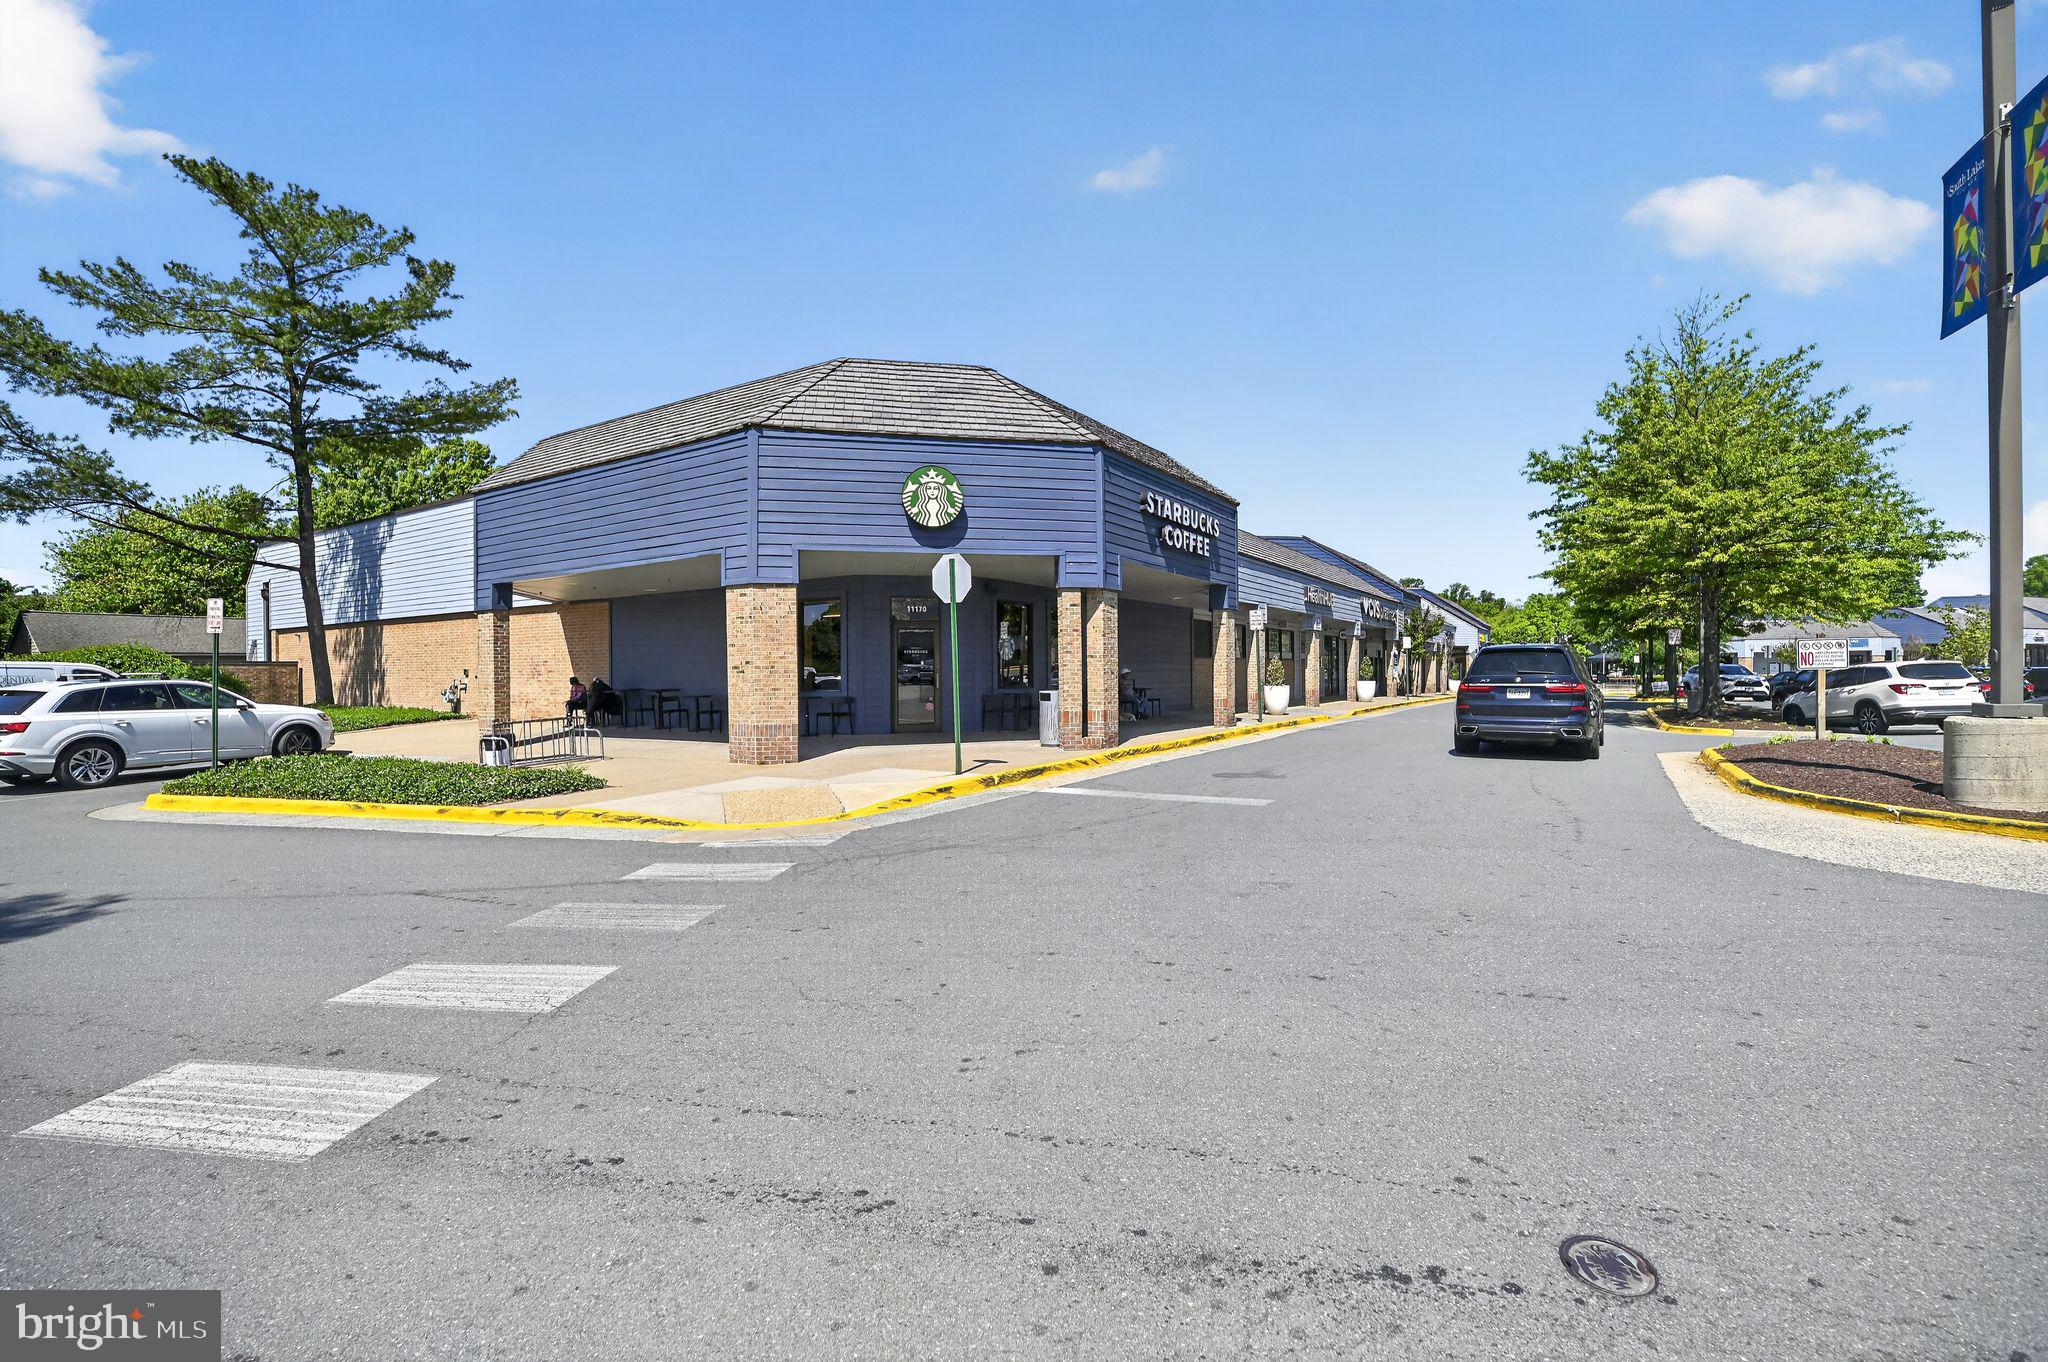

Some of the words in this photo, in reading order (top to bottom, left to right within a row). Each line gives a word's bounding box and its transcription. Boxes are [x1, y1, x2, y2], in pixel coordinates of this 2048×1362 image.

[1146, 491, 1220, 537] STARBUCKS
[1164, 524, 1210, 557] COFFEE
[907, 605, 927, 613] 11170
[1800, 651, 1815, 666] NO
